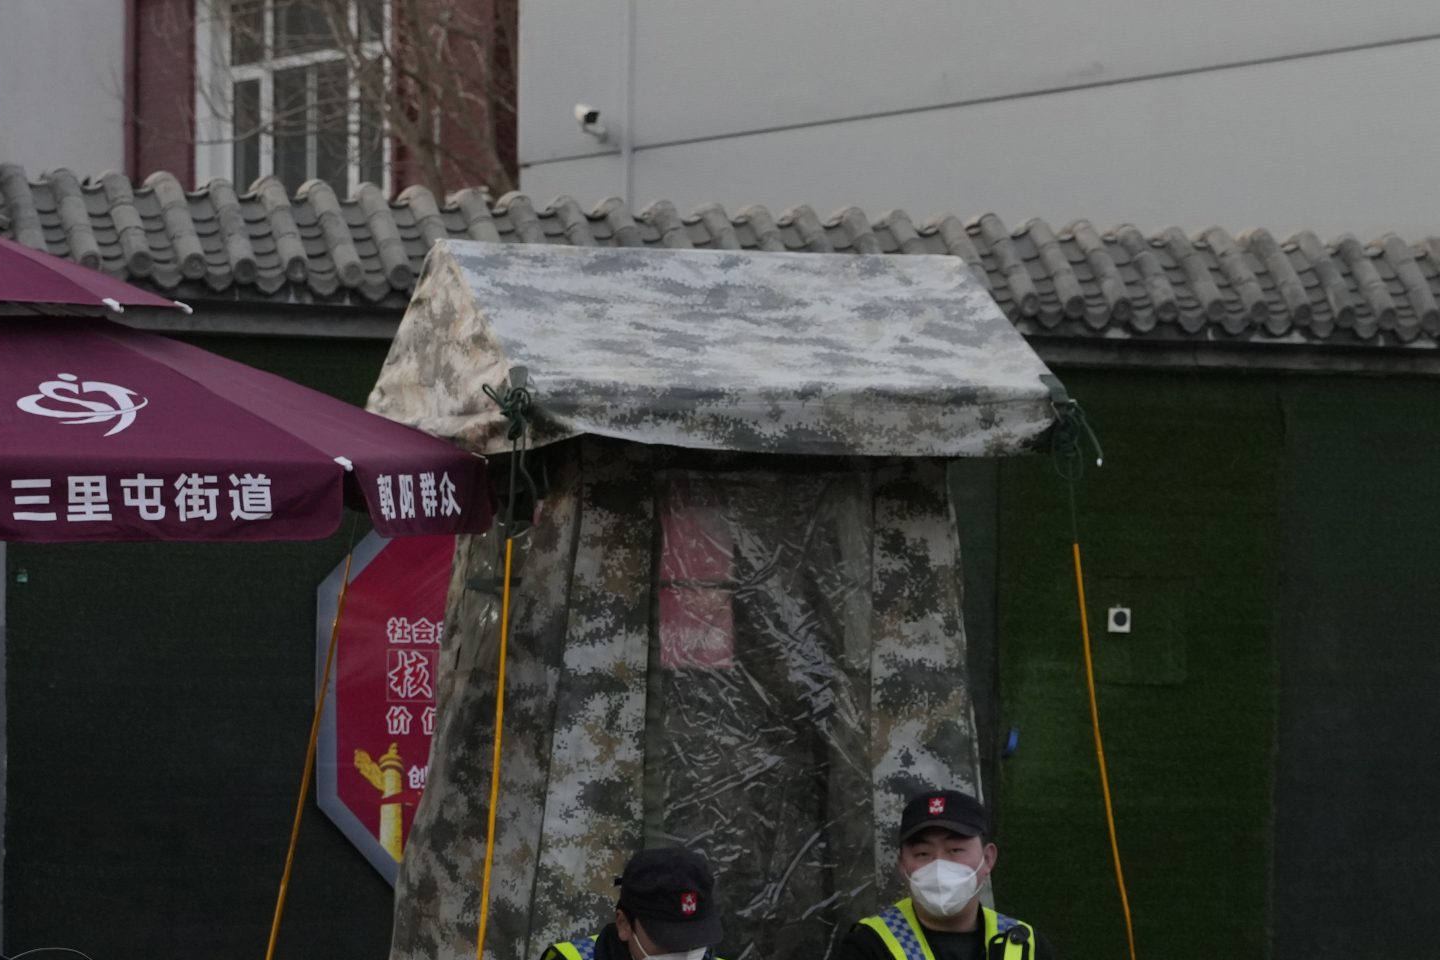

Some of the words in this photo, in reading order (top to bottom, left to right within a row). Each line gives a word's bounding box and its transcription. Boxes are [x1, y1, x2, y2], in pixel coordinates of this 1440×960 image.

[10, 472, 274, 522] 三里屯街道
[376, 470, 462, 520] 朝阳群众
[388, 650, 433, 699] 核
